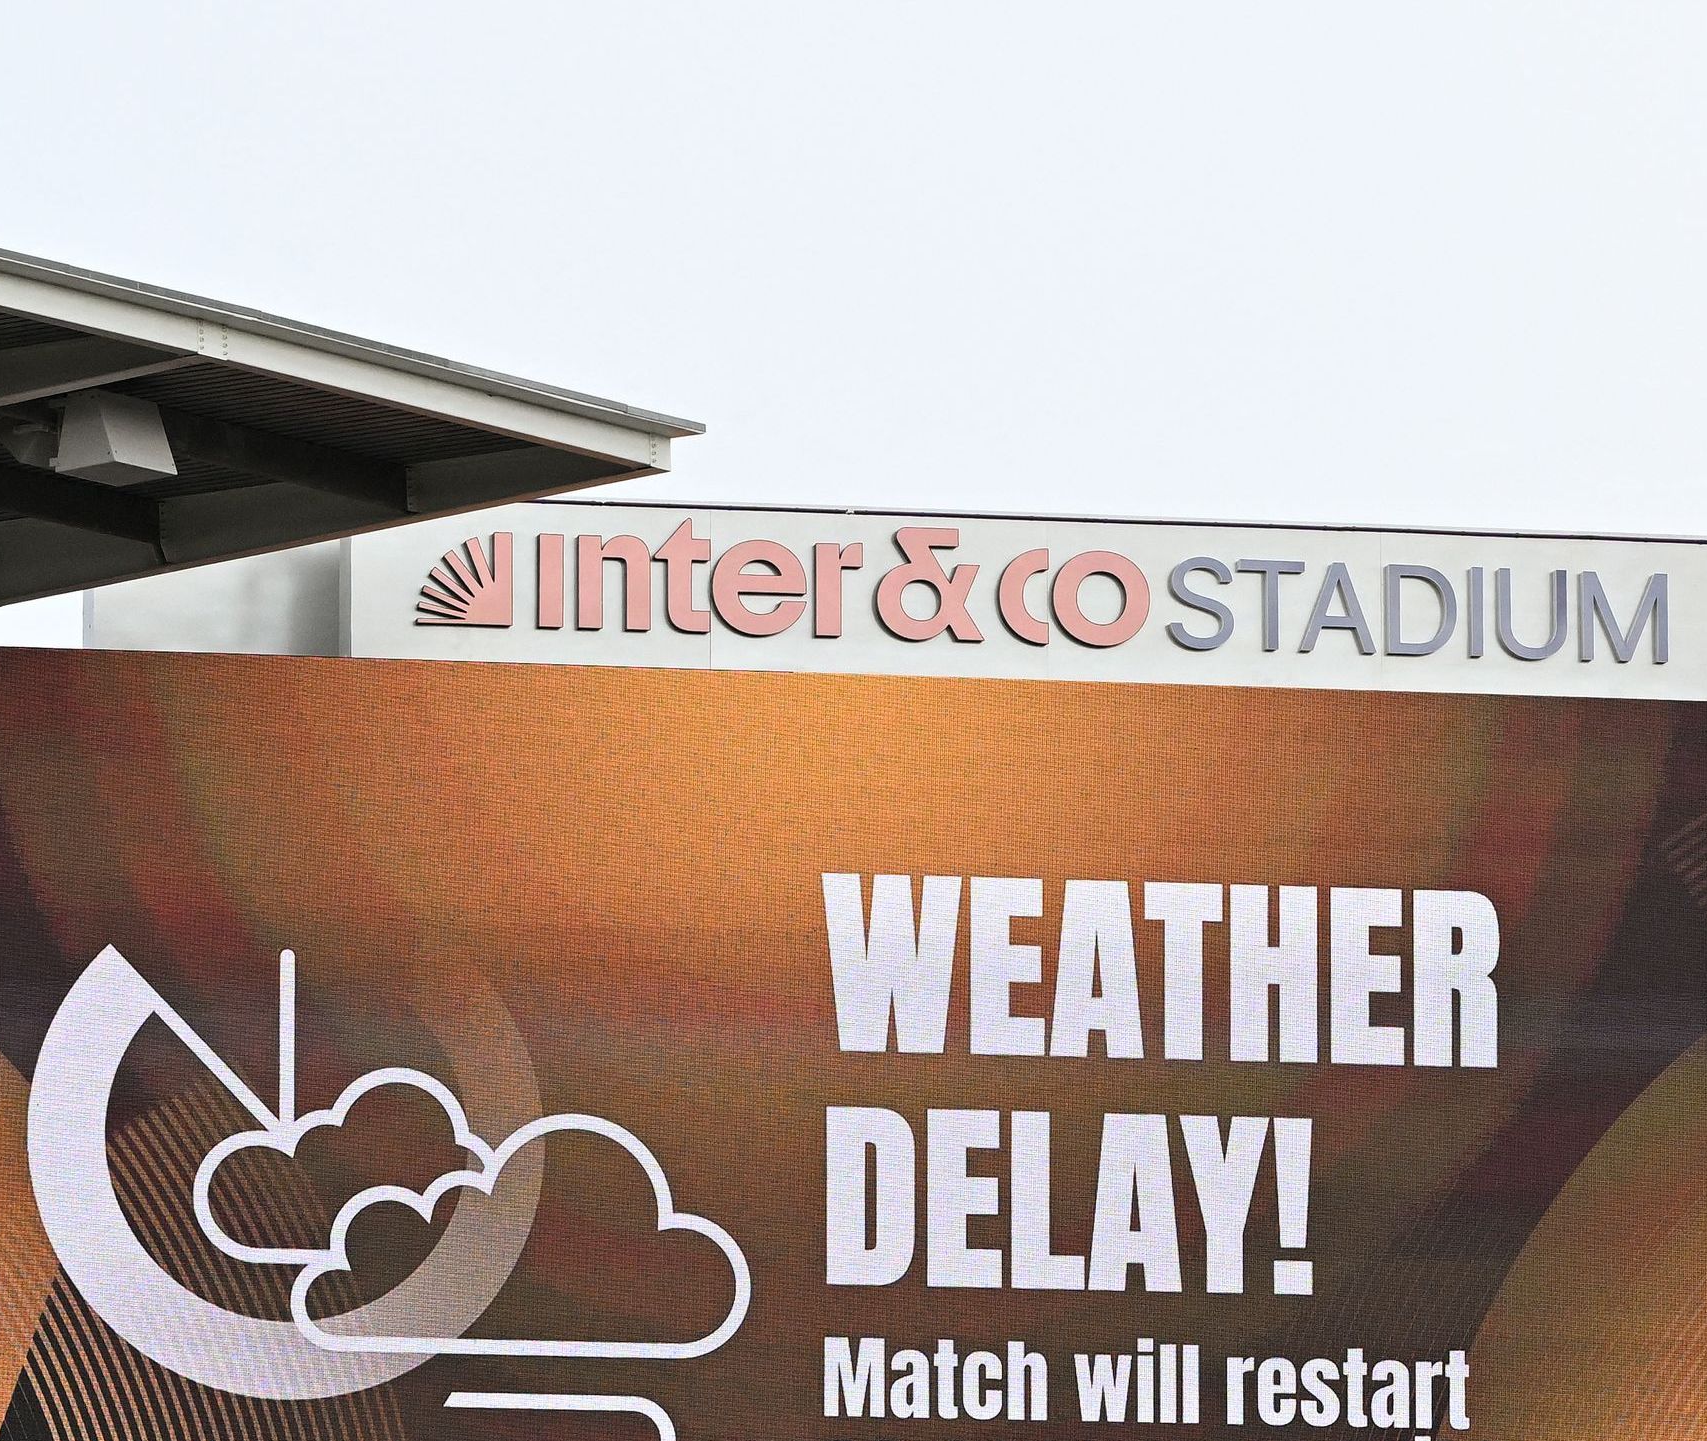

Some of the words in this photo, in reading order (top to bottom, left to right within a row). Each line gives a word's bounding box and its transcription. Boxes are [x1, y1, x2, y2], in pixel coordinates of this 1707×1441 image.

[1167, 553, 1669, 664] STADIUM
[820, 872, 1500, 1068] WEATHER
[825, 1105, 1313, 1295] DELAY!
[822, 1336, 1048, 1422] Match
[1073, 1337, 1200, 1425] will
[1225, 1347, 1470, 1430] restart
